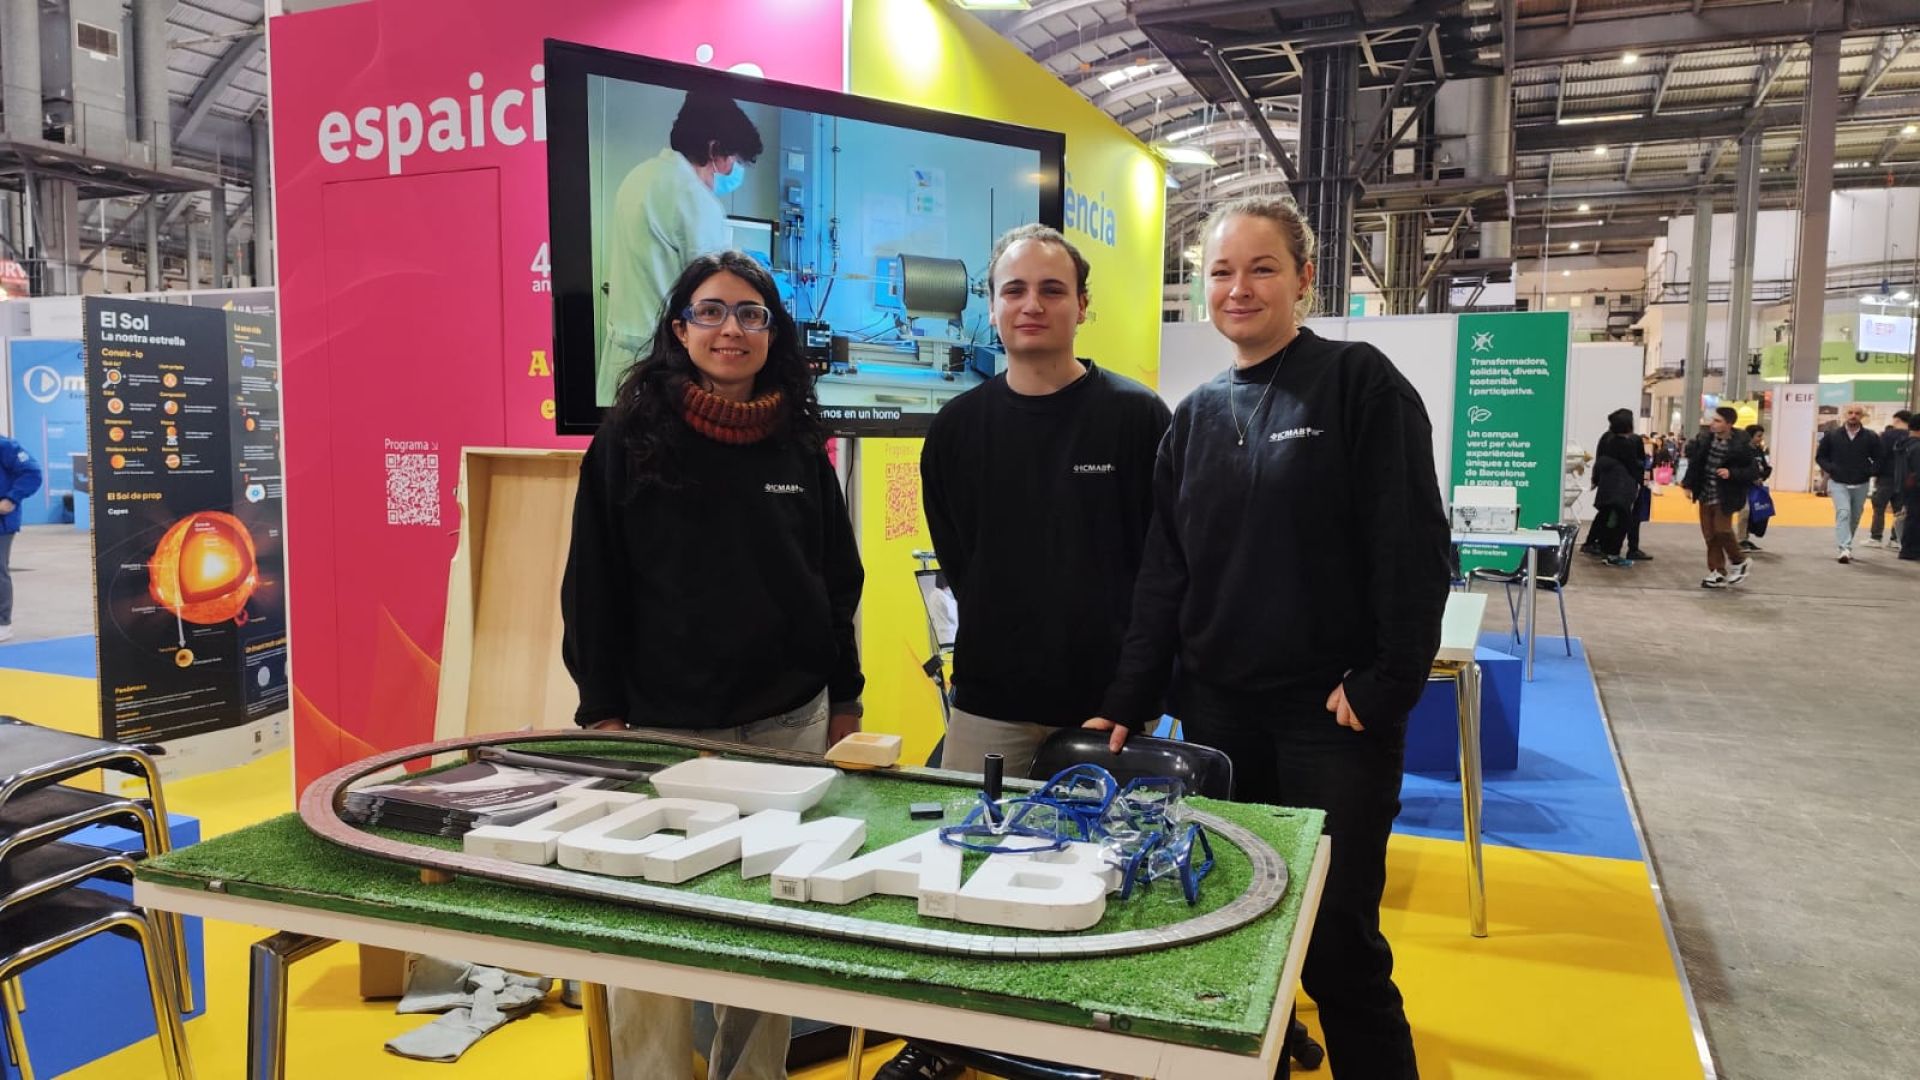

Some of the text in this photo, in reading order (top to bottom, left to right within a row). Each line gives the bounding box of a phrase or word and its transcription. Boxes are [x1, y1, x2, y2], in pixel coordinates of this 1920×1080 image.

[318, 63, 547, 175] espaici
[1064, 171, 1116, 247] ència
[100, 311, 150, 331] El Sol
[101, 331, 186, 347] La nostra estrella
[1512, 367, 1549, 376] diversa,
[844, 410, 857, 419] en
[858, 410, 871, 420] un
[1467, 430, 1519, 440] Un campus
[384, 438, 429, 453] Programa
[1466, 440, 1487, 448] verd
[1488, 441, 1505, 449] per
[1511, 460, 1537, 468] tocar
[1465, 468, 1526, 477] de Barcelona
[1515, 479, 1529, 487] tot
[107, 491, 162, 502] El Sol de prop
[1471, 549, 1508, 557] Barcelona
[464, 777, 1122, 932] ICMAB
